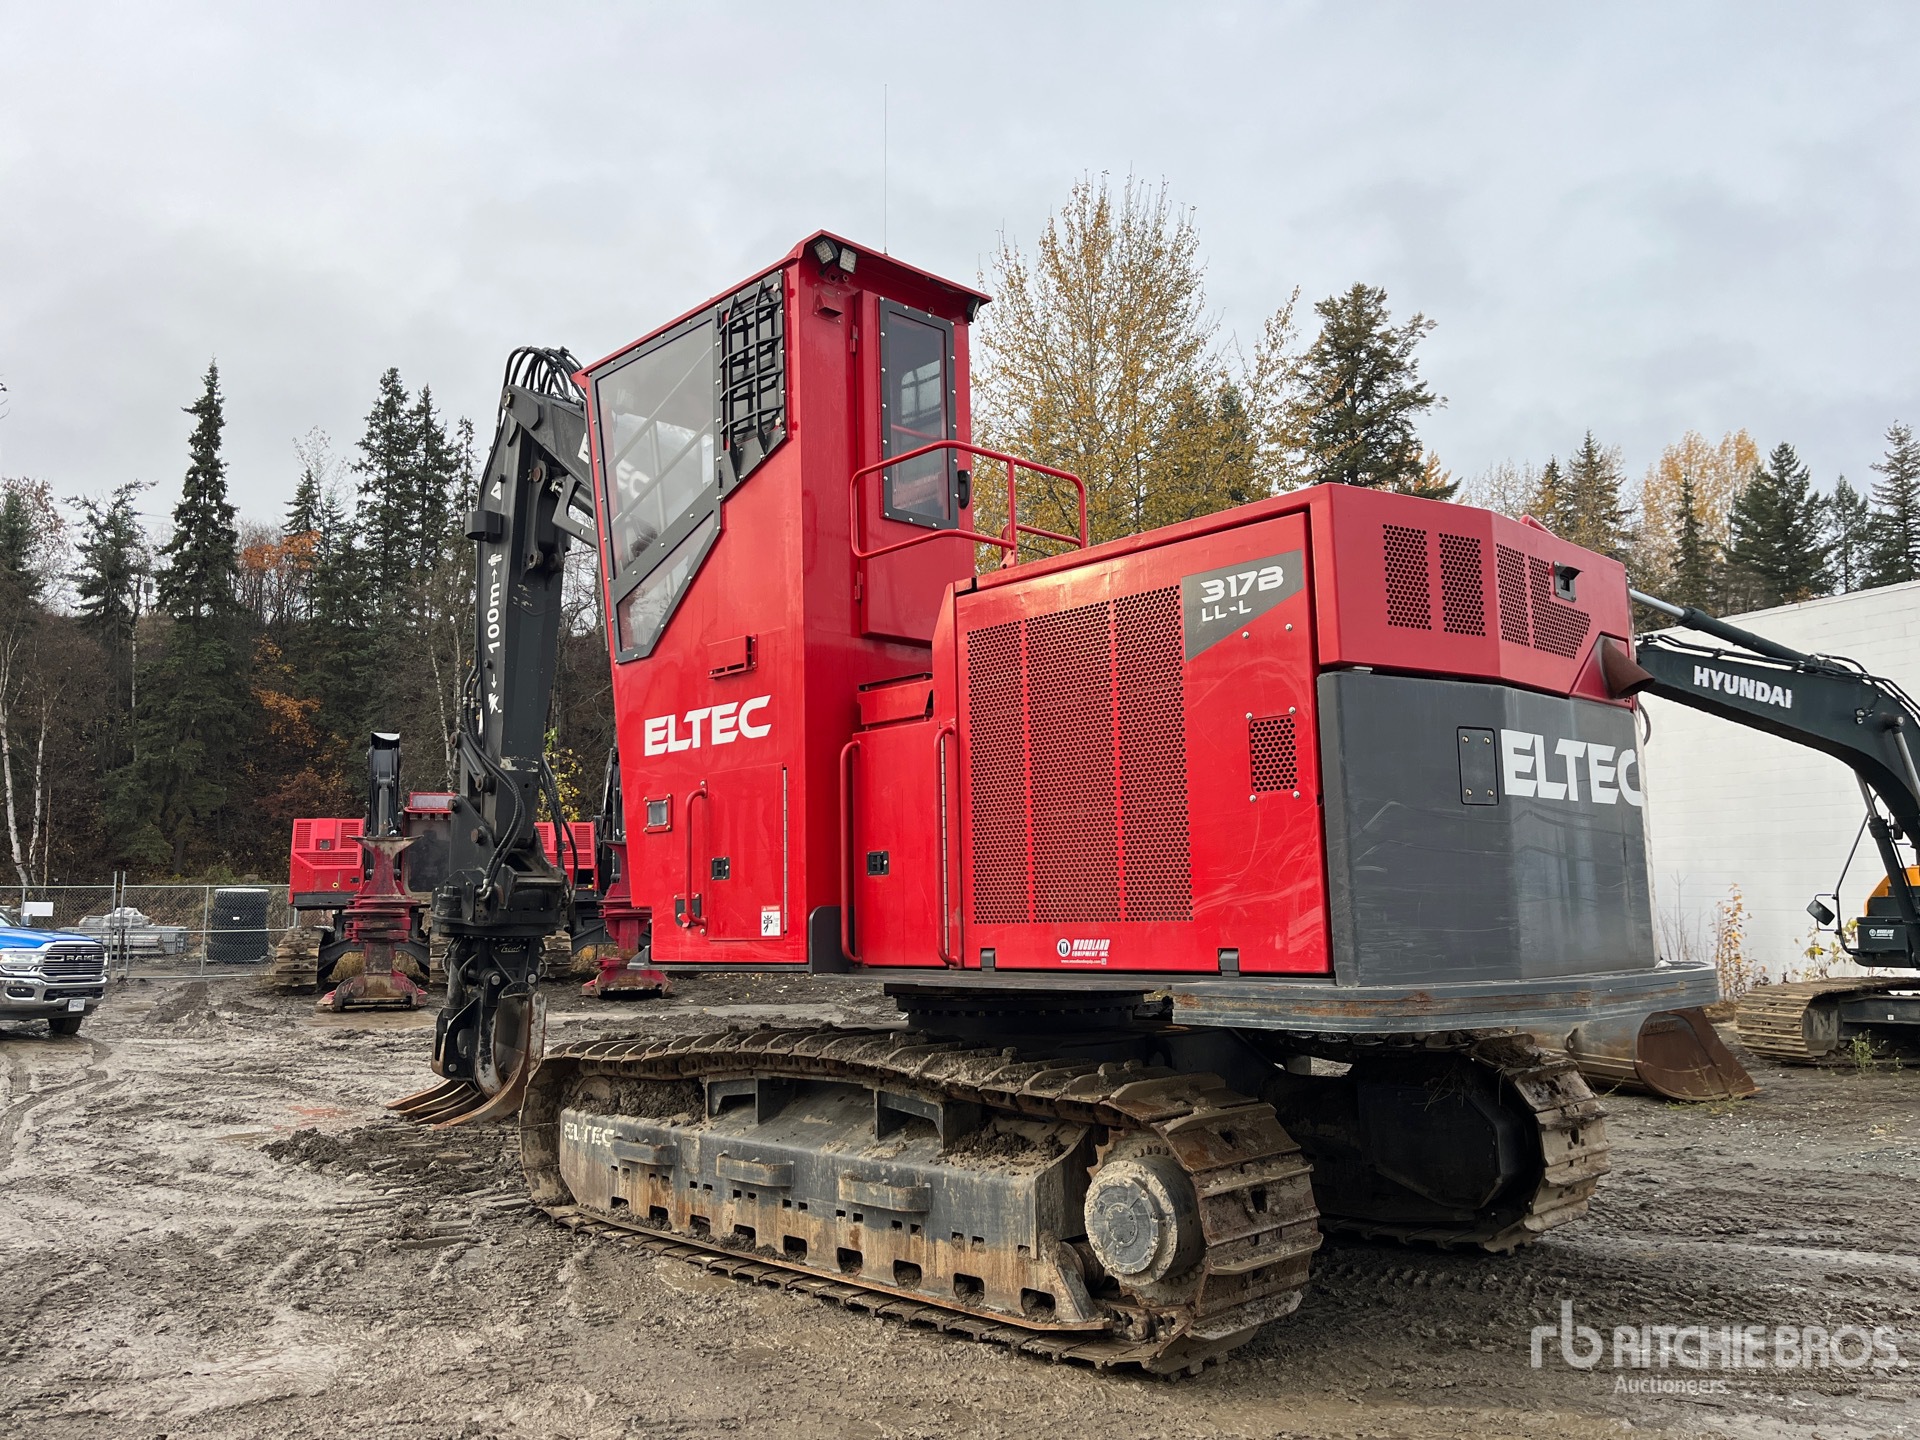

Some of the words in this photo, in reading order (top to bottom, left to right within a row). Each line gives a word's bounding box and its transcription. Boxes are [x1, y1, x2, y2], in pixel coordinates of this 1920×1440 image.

[1200, 565, 1284, 604] 317B
[487, 582, 501, 654] 100m
[1201, 599, 1252, 622] LL-L
[1693, 665, 1793, 709] HYUNDAI
[644, 694, 772, 757] ELTEC
[1500, 729, 1643, 807] ELTEC
[564, 1121, 615, 1148] ELTEC
